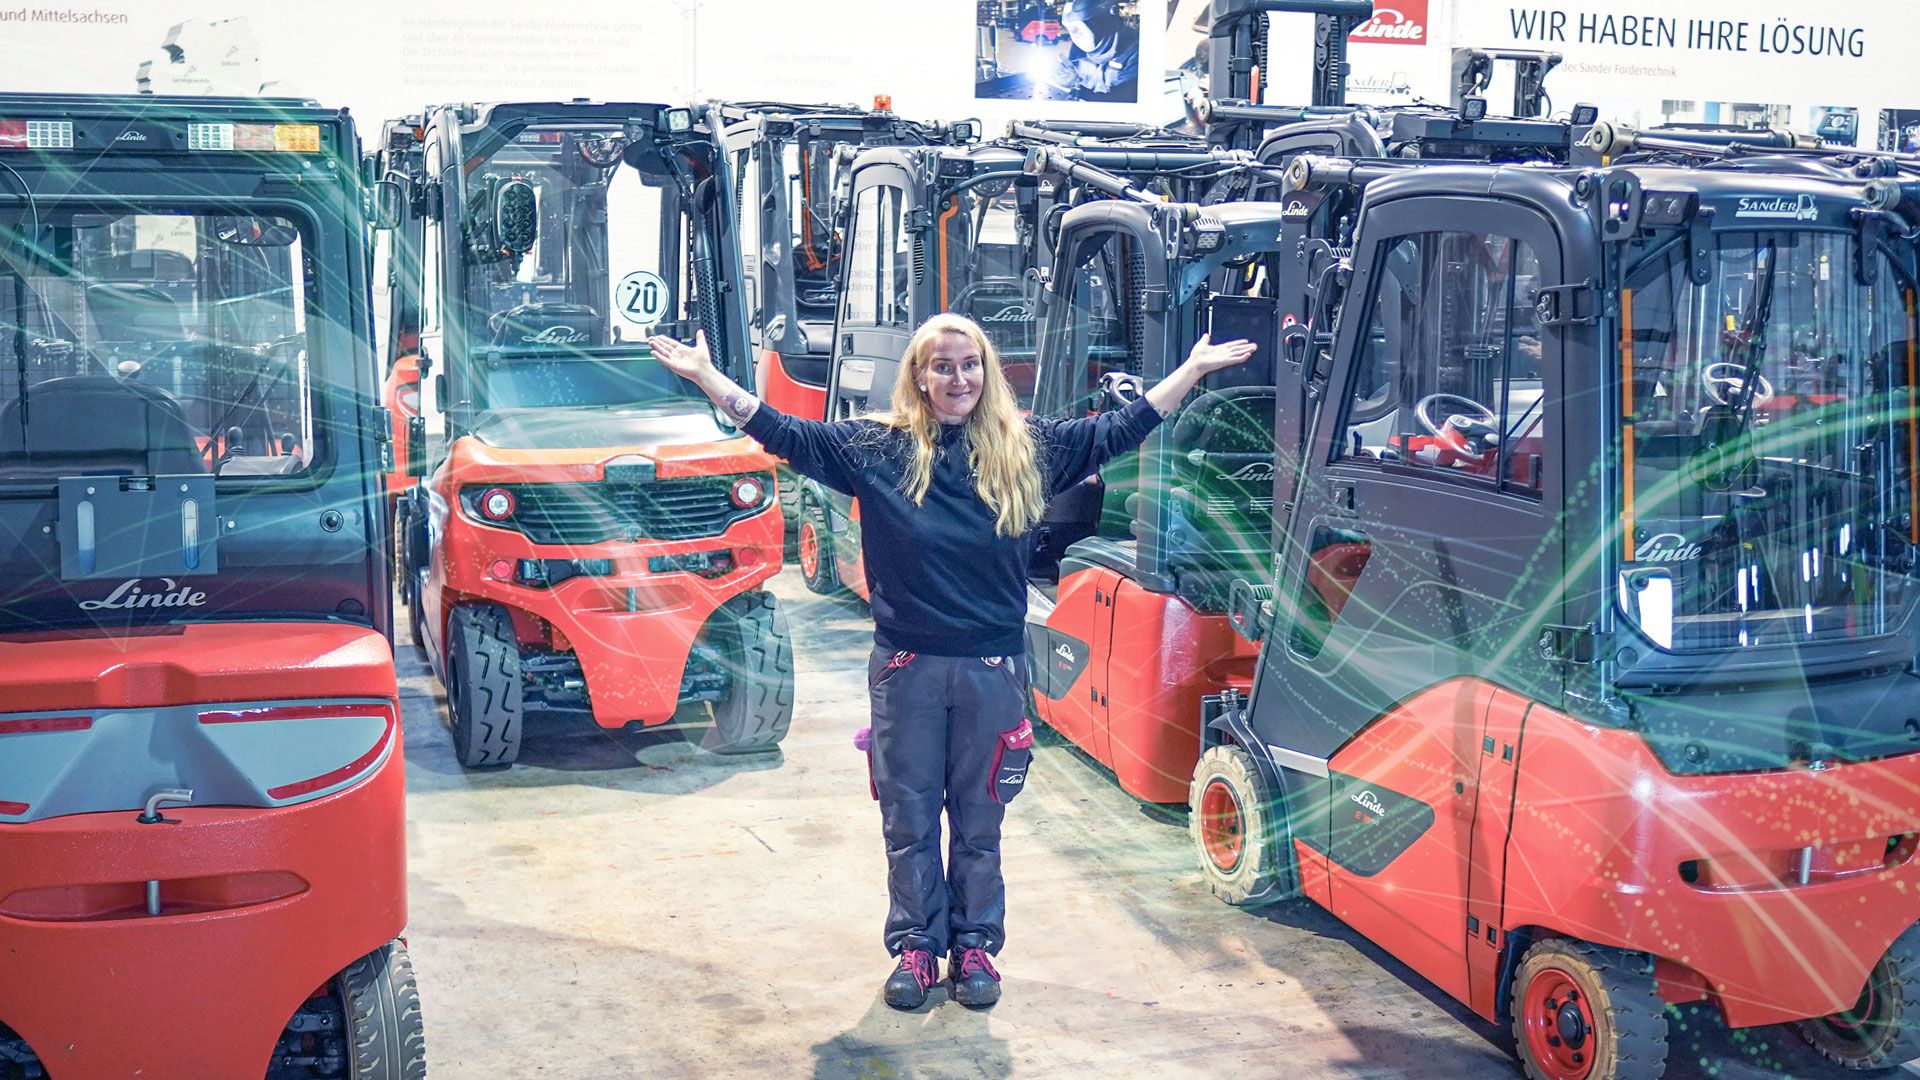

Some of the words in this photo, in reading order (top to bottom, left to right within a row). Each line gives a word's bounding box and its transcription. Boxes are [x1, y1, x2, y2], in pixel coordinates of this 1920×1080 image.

[0, 8, 26, 22] und
[32, 9, 128, 25] Mittelsachsen
[1348, 8, 1424, 40] Linde
[1510, 8, 1567, 42] WIR
[1578, 12, 1676, 49] HABEN
[1688, 19, 1749, 52] IHRE
[1760, 17, 1865, 58] LÖSUNG
[1561, 62, 1577, 73] der
[1580, 62, 1612, 74] Sander
[1614, 64, 1677, 78] Fördertechnik
[115, 131, 147, 141] Linde
[1282, 200, 1308, 216] Linde
[627, 281, 657, 314] 20
[982, 305, 1036, 322] Lind
[521, 325, 590, 344] Linde
[1216, 462, 1274, 481] Lin
[1634, 533, 1703, 562] Linde
[78, 578, 207, 610] Linde
[1351, 790, 1385, 818] Linde
